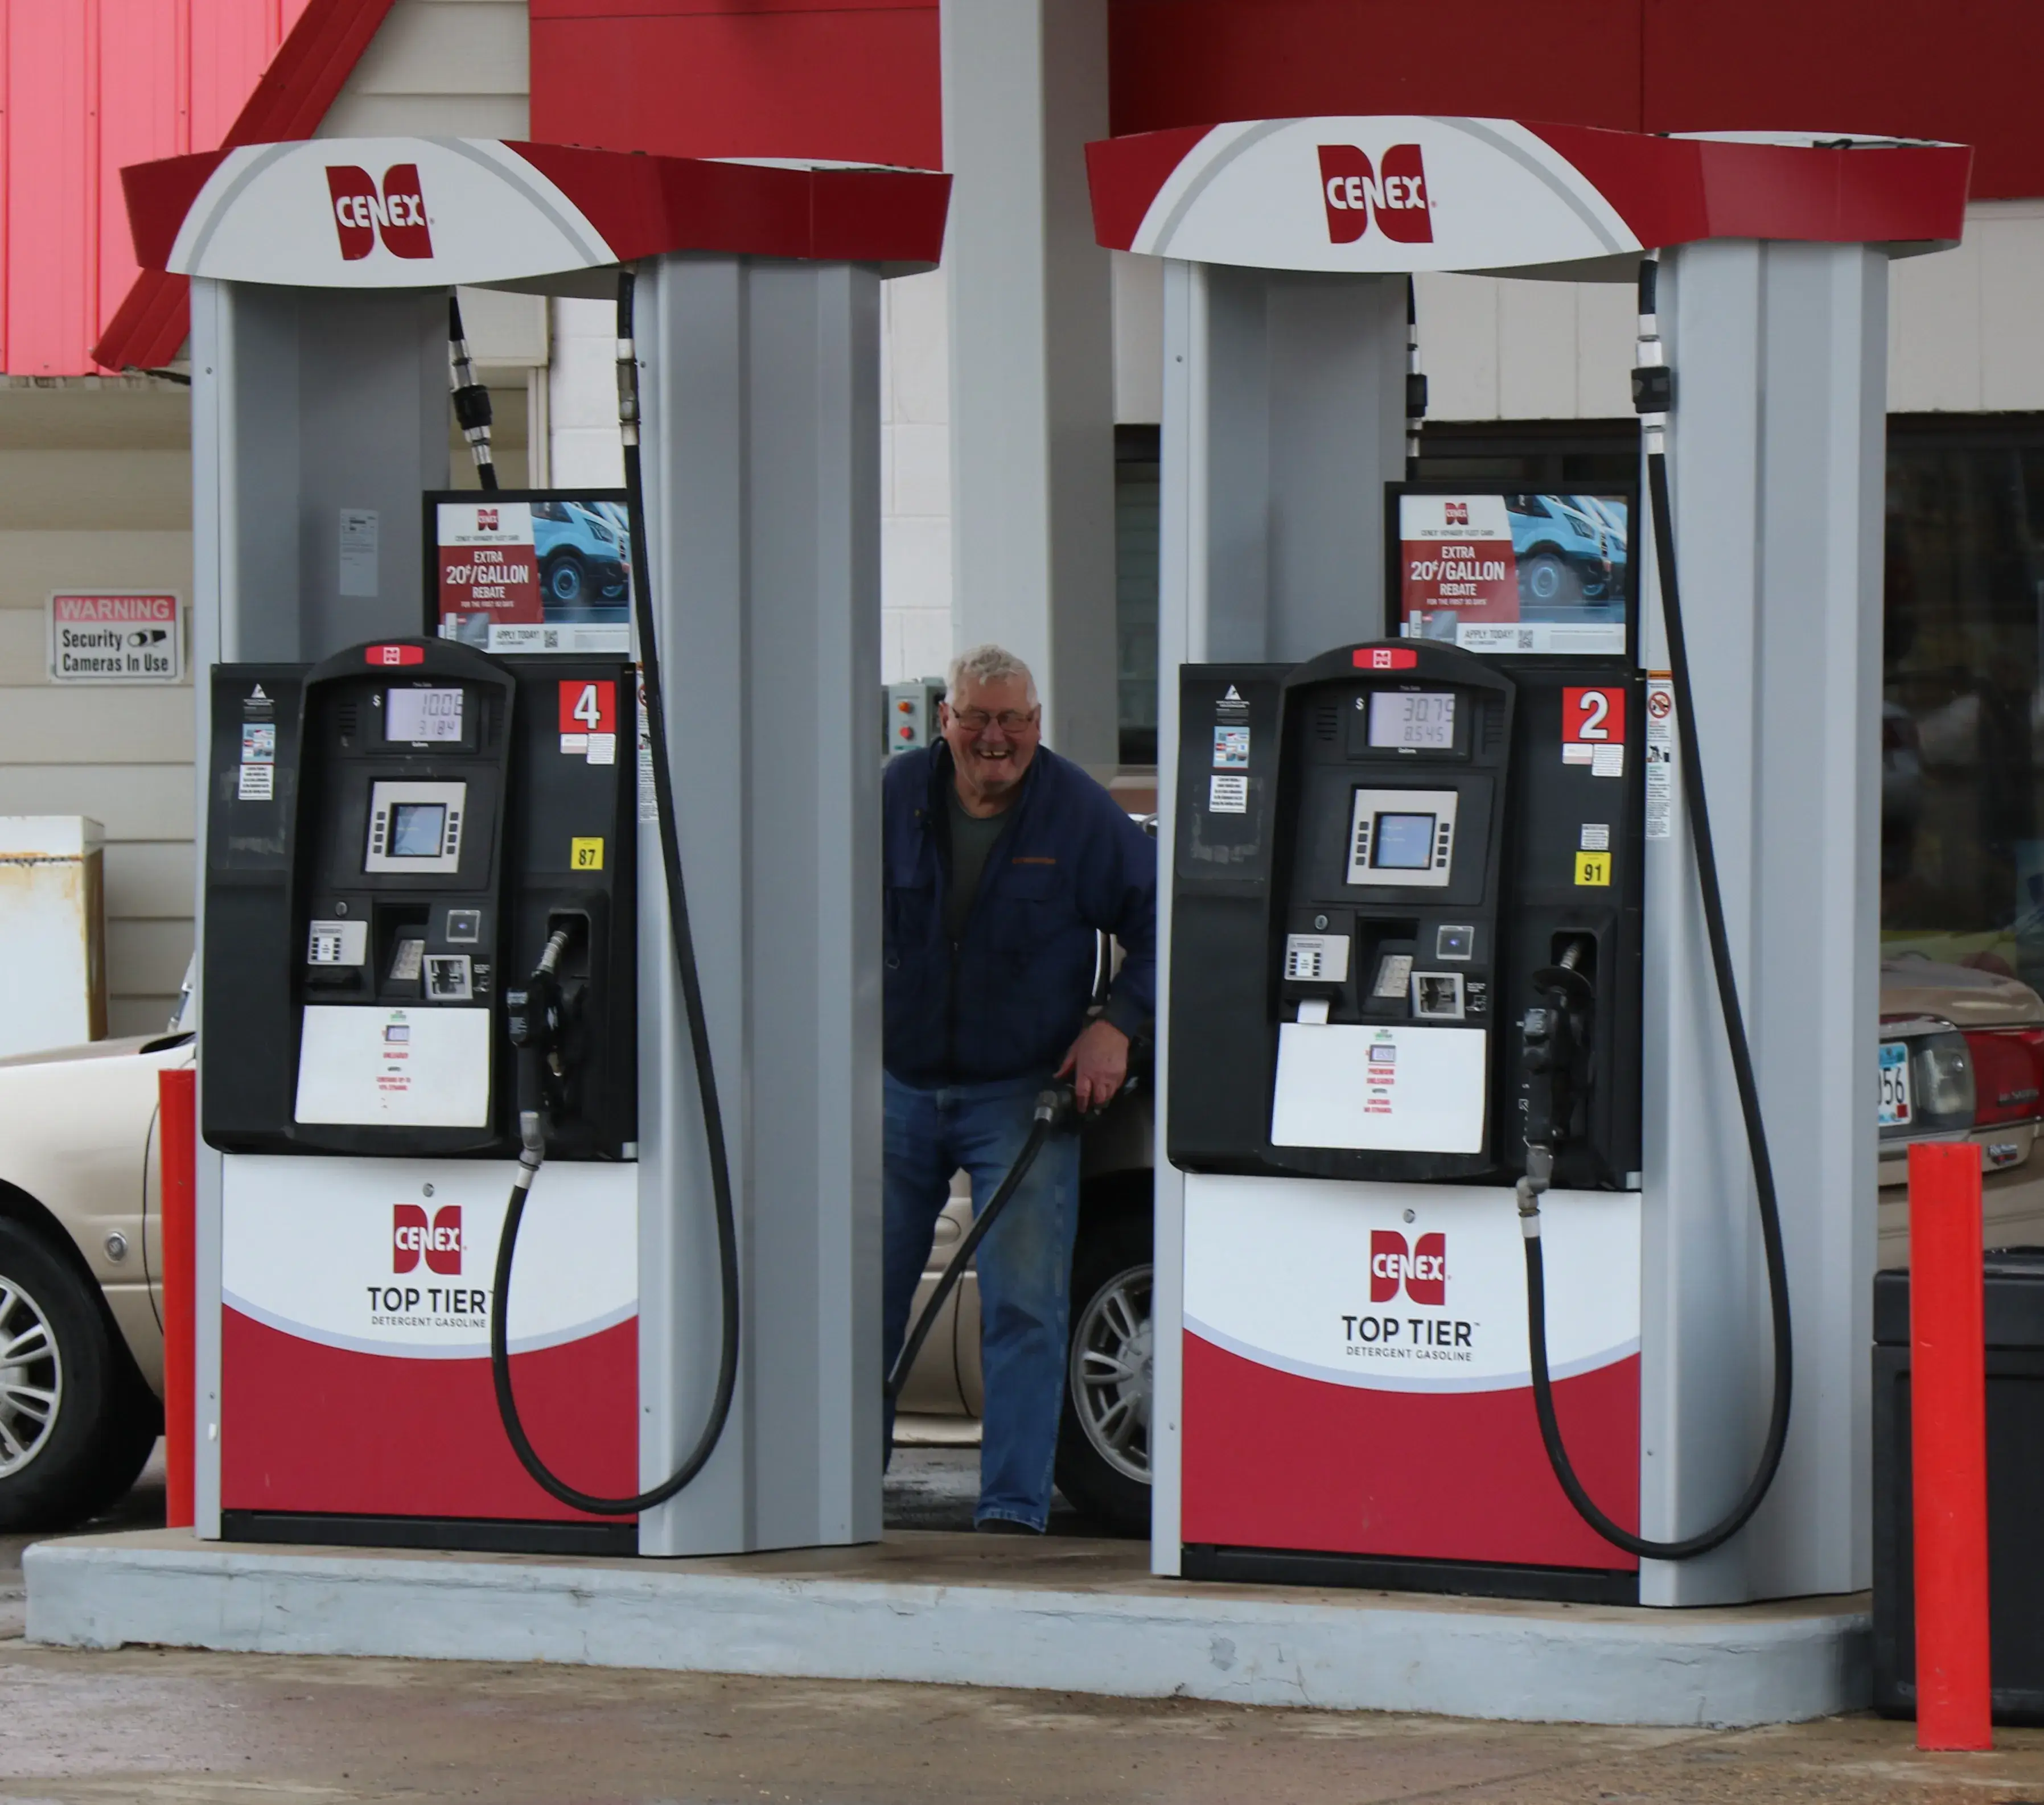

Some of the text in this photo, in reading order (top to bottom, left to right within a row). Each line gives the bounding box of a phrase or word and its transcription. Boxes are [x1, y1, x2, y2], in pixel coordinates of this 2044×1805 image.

[1327, 176, 1425, 209] CENEX
[336, 194, 426, 228] CENEX
[474, 551, 504, 563] EXTRA
[1442, 546, 1475, 558] EXTRA
[472, 586, 505, 598] REBATE
[1440, 583, 1477, 596] REBATE
[60, 599, 170, 619] WARNING
[63, 628, 122, 652] Security
[63, 653, 168, 671] Cameras In Use
[373, 694, 381, 708] $
[573, 684, 601, 729] 4
[1356, 697, 1364, 710] $
[1579, 690, 1609, 739] 2
[579, 849, 596, 866] 87
[1584, 864, 1601, 882] 91
[396, 1227, 460, 1251] CENEX
[1372, 1253, 1443, 1281] CENEX
[367, 1288, 486, 1314] TOP TIER
[372, 1316, 486, 1328] DETERGENT GASOLINE
[1342, 1316, 1472, 1347] TOP TIER
[1347, 1346, 1472, 1362] DETERGENT GASOLINE
